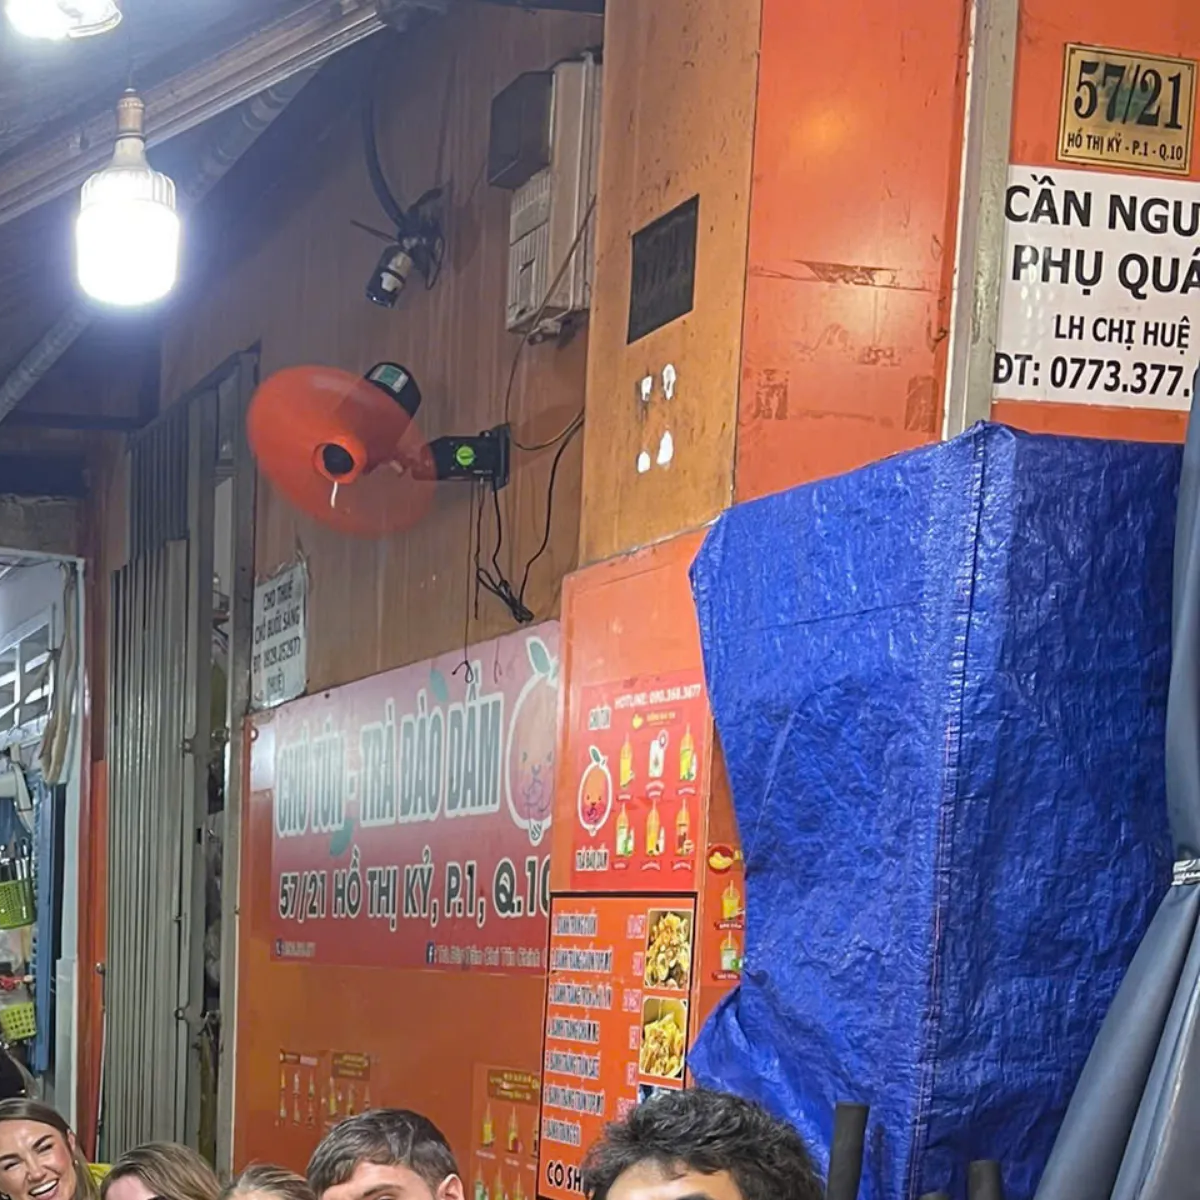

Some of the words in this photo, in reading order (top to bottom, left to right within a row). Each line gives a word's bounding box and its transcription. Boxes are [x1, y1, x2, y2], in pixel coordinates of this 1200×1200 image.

[1074, 60, 1183, 130] 57/21
[1132, 140, 1148, 156] P.1
[1159, 143, 1183, 161] Q.10
[1004, 174, 1092, 228] CẦN
[1012, 244, 1103, 296] PHỤ
[1055, 314, 1085, 340] LH
[1092, 317, 1136, 351] CHỊ
[1143, 315, 1190, 355] HUỆ
[993, 352, 1040, 387] ĐT:
[278, 871, 327, 923] 57/21
[332, 844, 361, 919] HỒ
[366, 865, 398, 932] THỊ
